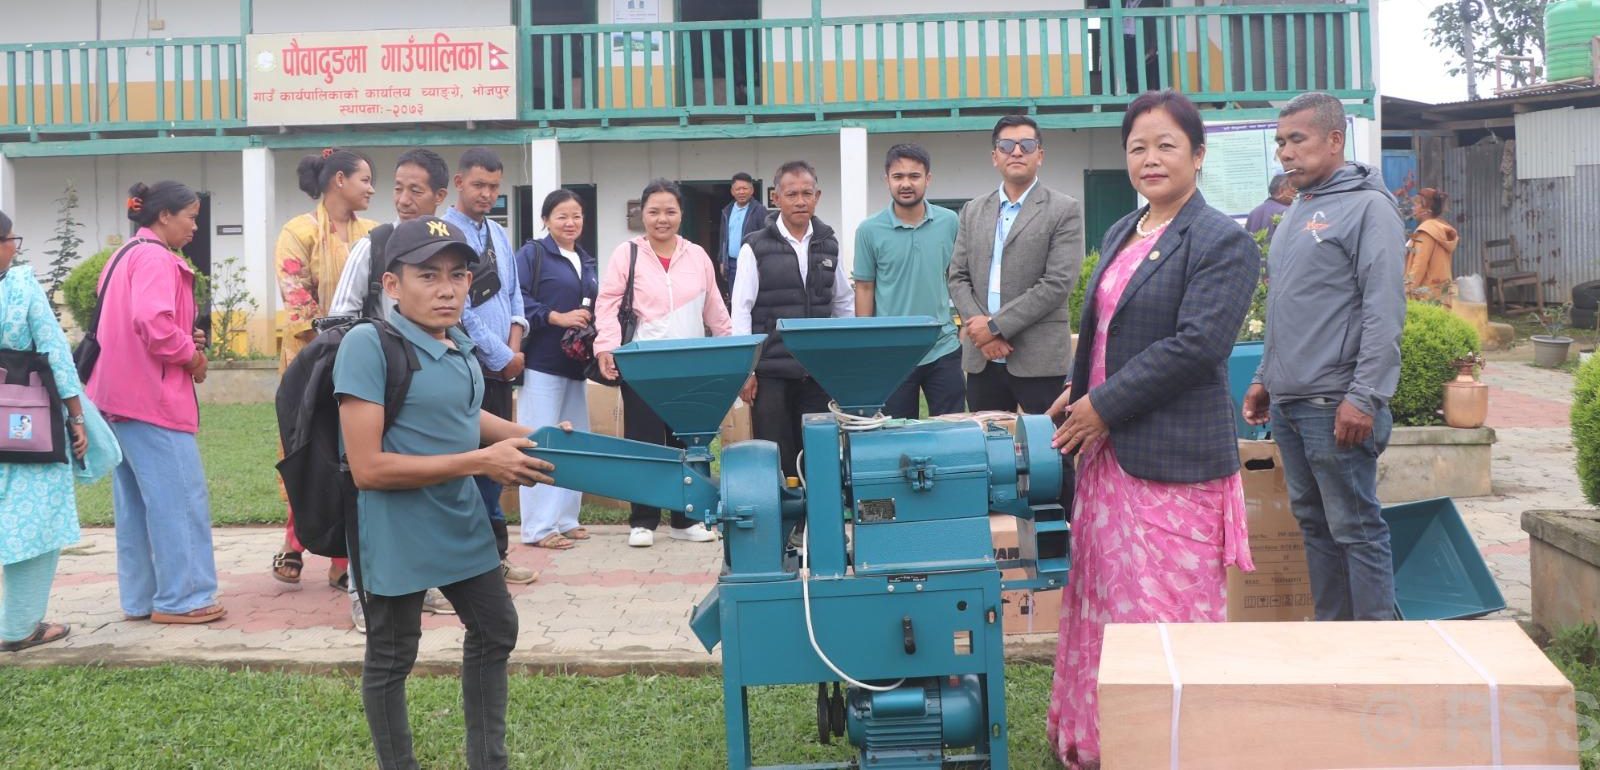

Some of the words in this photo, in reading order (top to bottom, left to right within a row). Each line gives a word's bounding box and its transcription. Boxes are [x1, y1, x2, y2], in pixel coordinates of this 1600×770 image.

[381, 32, 484, 73] गाउँपालिका
[253, 88, 275, 102] गाउँ
[280, 87, 358, 101] कार्यपालिकाको
[365, 85, 411, 98] कार्यालय
[472, 84, 511, 99] भोजपुर
[426, 220, 450, 237] NY
